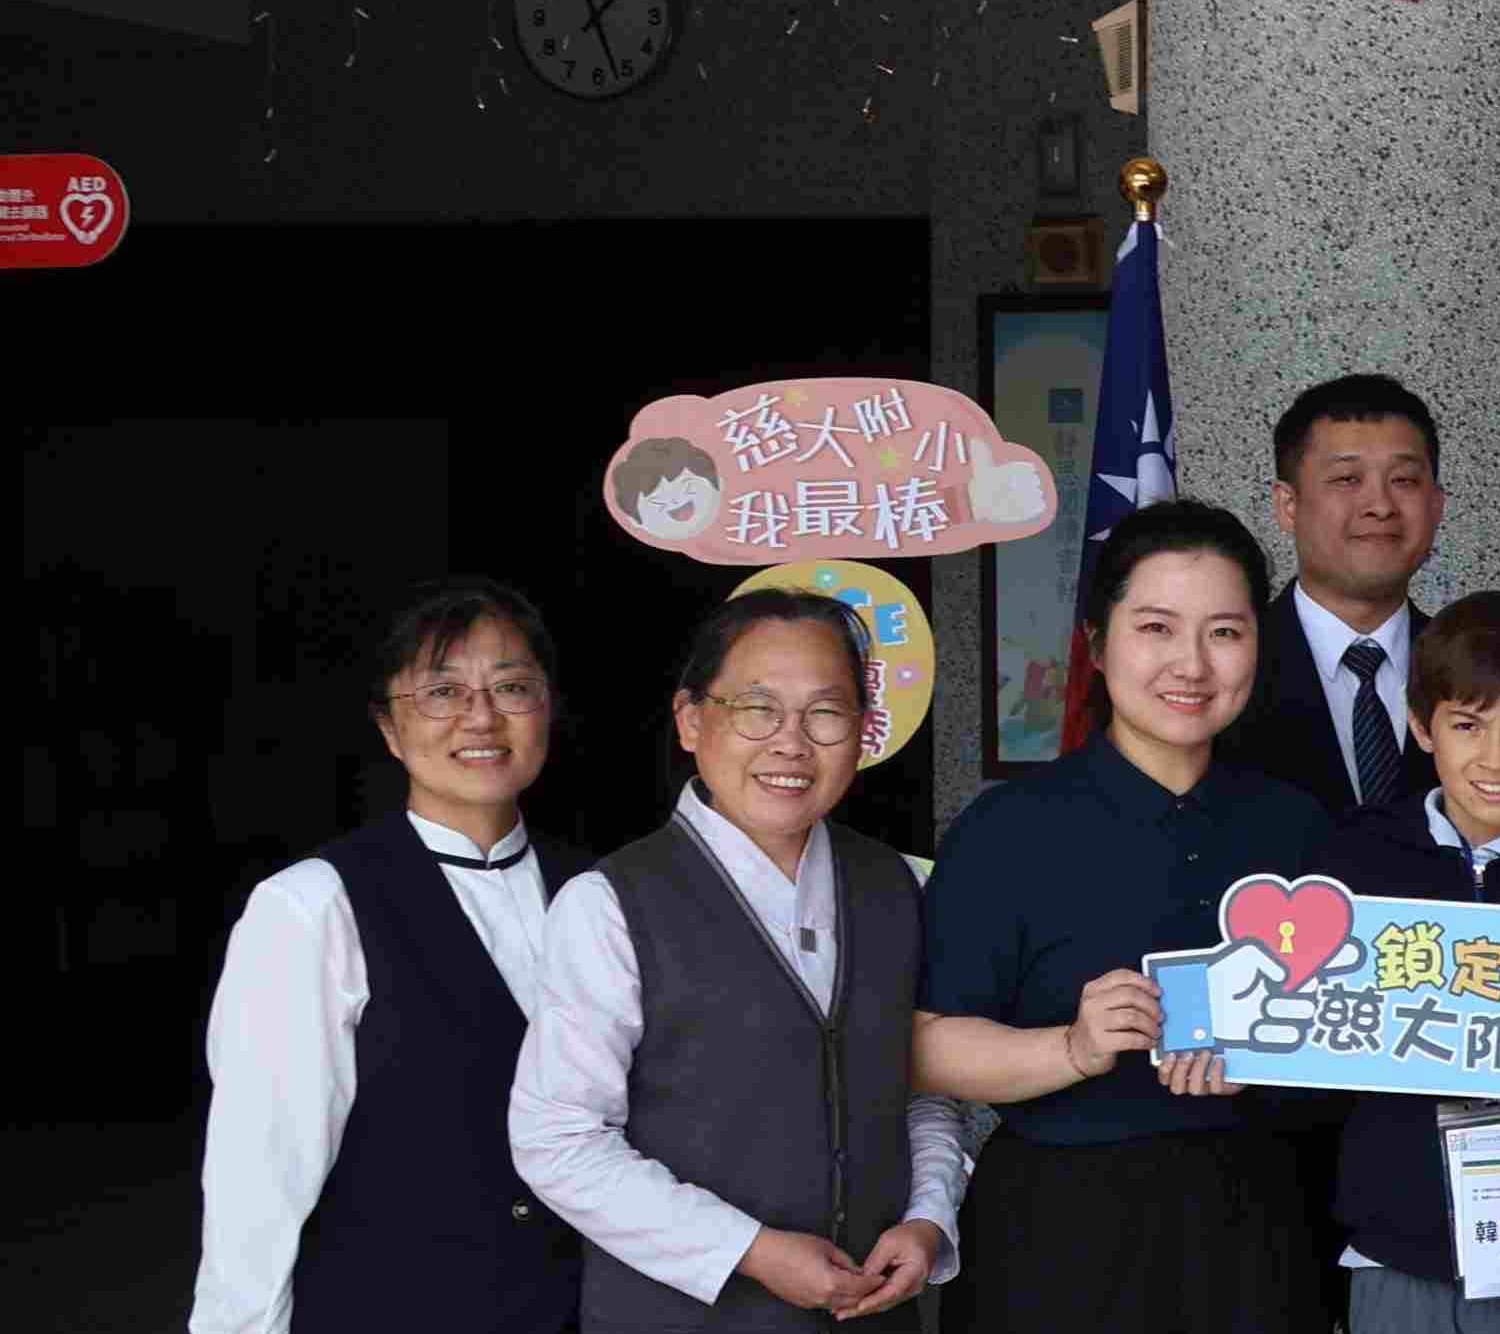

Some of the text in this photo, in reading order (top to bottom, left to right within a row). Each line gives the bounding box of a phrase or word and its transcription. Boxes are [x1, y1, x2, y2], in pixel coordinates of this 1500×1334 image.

[66, 176, 107, 192] AED
[715, 387, 970, 473] 慈大附小
[726, 476, 952, 550] 我最棒
